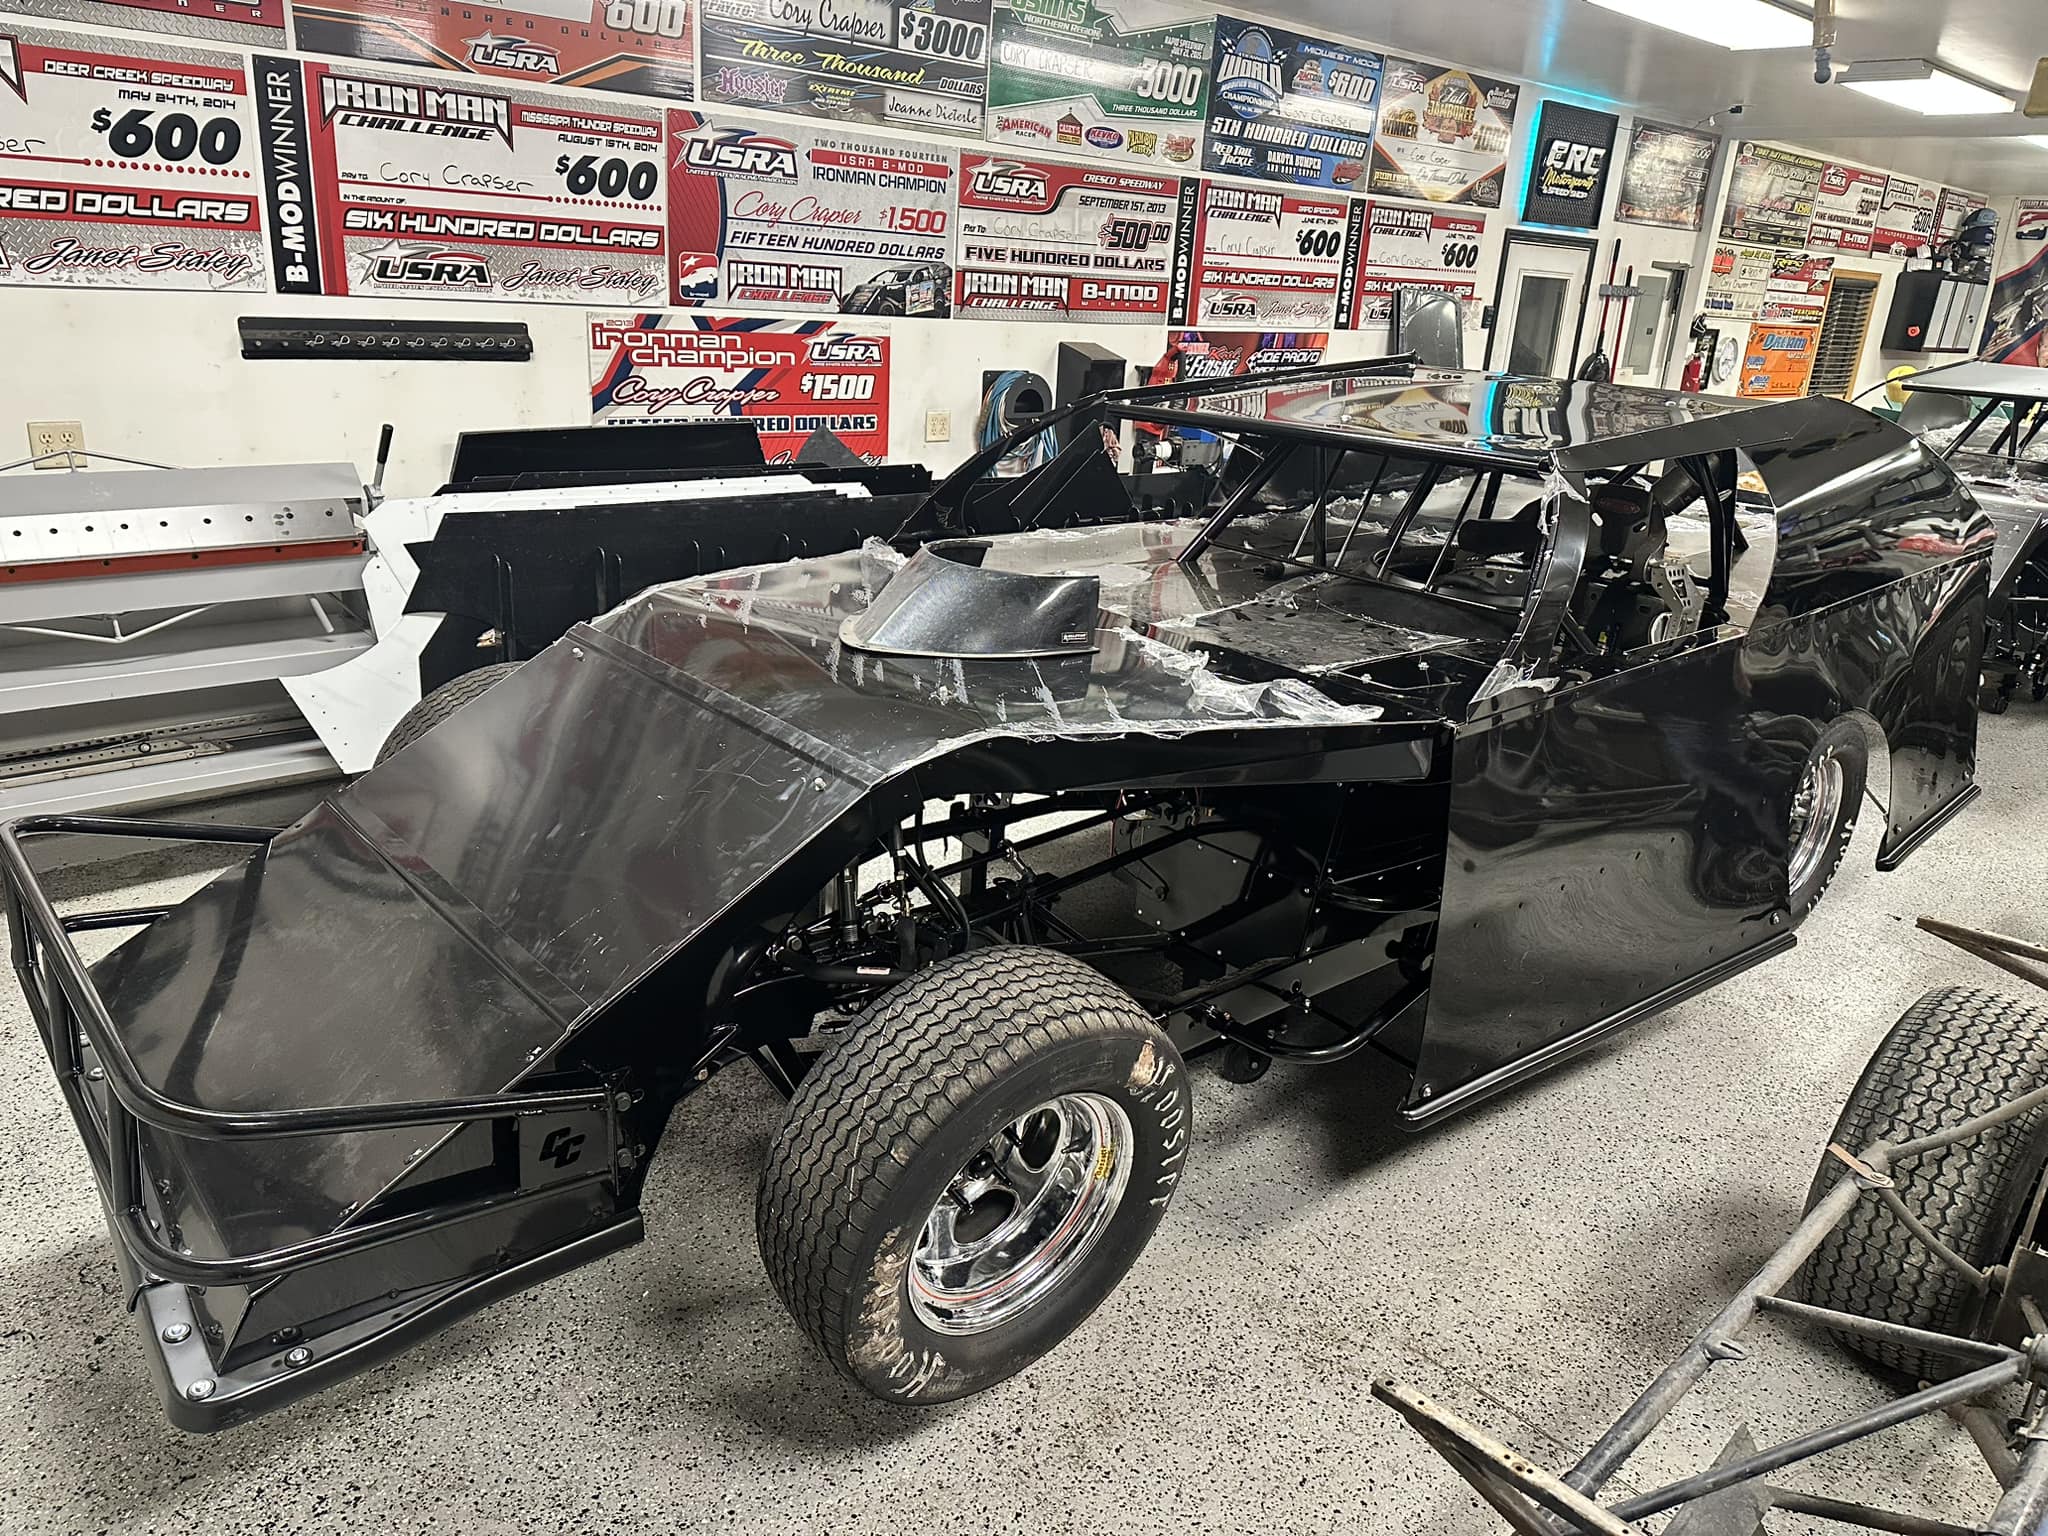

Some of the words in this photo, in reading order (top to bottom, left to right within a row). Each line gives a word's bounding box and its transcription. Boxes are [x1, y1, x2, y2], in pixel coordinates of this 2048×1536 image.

[769, 0, 813, 36] Cory
[819, 0, 886, 45] Crapser
[900, 10, 984, 60] $3000
[1024, 14, 1070, 31] NORTHERN
[473, 45, 560, 74] USRA
[733, 37, 807, 65] Three
[812, 50, 926, 85] Thousand
[1304, 46, 1351, 61] MIDWEST
[45, 60, 89, 76] DEER
[93, 65, 148, 83] CREEK
[151, 71, 234, 92] SPEEDWAY
[717, 67, 787, 100] Hoosier
[940, 78, 984, 95] DOLLARS
[1216, 54, 1284, 98] WORLD
[1328, 69, 1376, 102] $600
[118, 89, 151, 102] MAY
[156, 92, 198, 107] 24TH,
[203, 96, 236, 110] 2014
[321, 77, 420, 119] IRON
[424, 89, 510, 138] MAN
[888, 96, 932, 118] Joanne
[1112, 104, 1133, 113] THREE
[1134, 106, 1168, 116] THOUSAND
[1168, 108, 1198, 118] DOLLARS
[1428, 100, 1476, 122] JAMBOREE
[91, 107, 242, 165] $600
[339, 113, 495, 142] CHALLENGE
[521, 111, 571, 126] MISSISSIPPI
[571, 118, 612, 132] THUNDER
[612, 122, 657, 138] SPEEDWAY
[1002, 117, 1053, 139] AMERICAN
[1015, 130, 1037, 139] RACER
[1211, 116, 1241, 137] SIX
[1243, 122, 1309, 149] HUNDRED
[1309, 133, 1368, 158] DOLLARS
[1382, 118, 1419, 138] WINNER
[558, 133, 603, 147] AUGUST
[634, 142, 658, 153] 2014
[814, 139, 836, 149] TWO
[840, 141, 896, 156] THOUSAND
[899, 149, 948, 163] FOURTEEN
[1212, 142, 1233, 156] RED
[687, 143, 797, 178] USRA
[838, 154, 875, 168] USRA
[881, 160, 924, 175] B-MOD
[1220, 154, 1255, 167] TACKLE
[1267, 150, 1294, 165] DAKOTA
[1295, 154, 1323, 169] BUMPER
[1547, 140, 1606, 175] ERC
[341, 171, 357, 179] PAY
[379, 162, 432, 188] Cory
[442, 165, 535, 192] Crapser
[554, 154, 658, 201] $600
[812, 166, 878, 187] IRONMAN
[878, 172, 947, 195] CHAMPION
[975, 173, 1047, 200] USRA
[1082, 173, 1117, 186] CRESCO
[1119, 177, 1165, 190] SPEEDWAY
[75, 191, 249, 222] DOLLARS
[352, 194, 366, 202] THE
[367, 196, 395, 204] AMOUNT
[734, 190, 788, 227] Cory
[788, 196, 862, 229] Crapser
[1078, 195, 1130, 211] SEPTEMBER
[1130, 200, 1146, 213] 1ST,
[1146, 202, 1167, 213] 2013
[1205, 187, 1244, 214] IRON
[1247, 192, 1282, 226] MAN
[344, 208, 395, 231] SIX
[399, 213, 534, 240] HUNDRED
[538, 222, 660, 248] DOLLARS
[879, 205, 948, 234] $1,500
[1209, 209, 1274, 224] CHALLENGE
[1369, 207, 1402, 229] IRON
[1404, 211, 1432, 240] MAN
[1100, 213, 1172, 250] $500.00
[1295, 229, 1342, 258] $600
[1372, 226, 1425, 239] CHALLENGE
[730, 230, 800, 248] FIFTEEN
[801, 236, 876, 255] HUNDRED
[878, 242, 945, 260] DOLLARS
[1441, 241, 1479, 269] $600
[26, 239, 135, 273] Janet
[139, 243, 251, 279] Staley
[375, 258, 491, 286] USRA
[964, 246, 1007, 261] FIVE
[1011, 249, 1090, 267] HUNDRED
[1093, 254, 1166, 272] DOLLARS
[502, 260, 577, 291] Janet
[579, 265, 659, 296] Staley
[729, 262, 787, 295] IRON
[790, 266, 841, 302] MAN
[964, 271, 1018, 298] IRON
[1021, 274, 1069, 306] MAN
[1202, 270, 1223, 284] SIX
[1224, 272, 1281, 287] HUNDRED
[1281, 275, 1336, 289] DOLLARS
[1363, 280, 1381, 291] SIX
[738, 288, 833, 305] CHALLENGE
[970, 296, 1060, 311] CHALLENGE
[1081, 282, 1159, 301] B-MOD
[1210, 301, 1258, 316] USRA
[604, 319, 634, 329] 2013
[594, 327, 742, 350] ironman
[1761, 333, 1808, 352] DREAM
[630, 346, 796, 371] champion
[810, 343, 882, 362] USRA
[1257, 351, 1280, 363] JOE
[1281, 350, 1322, 363] PROVO
[1187, 355, 1238, 377] FENSKE
[612, 375, 683, 413] Cory
[683, 377, 780, 413] Crapser
[800, 372, 874, 401] $1500
[795, 415, 877, 432] DOLLARS
